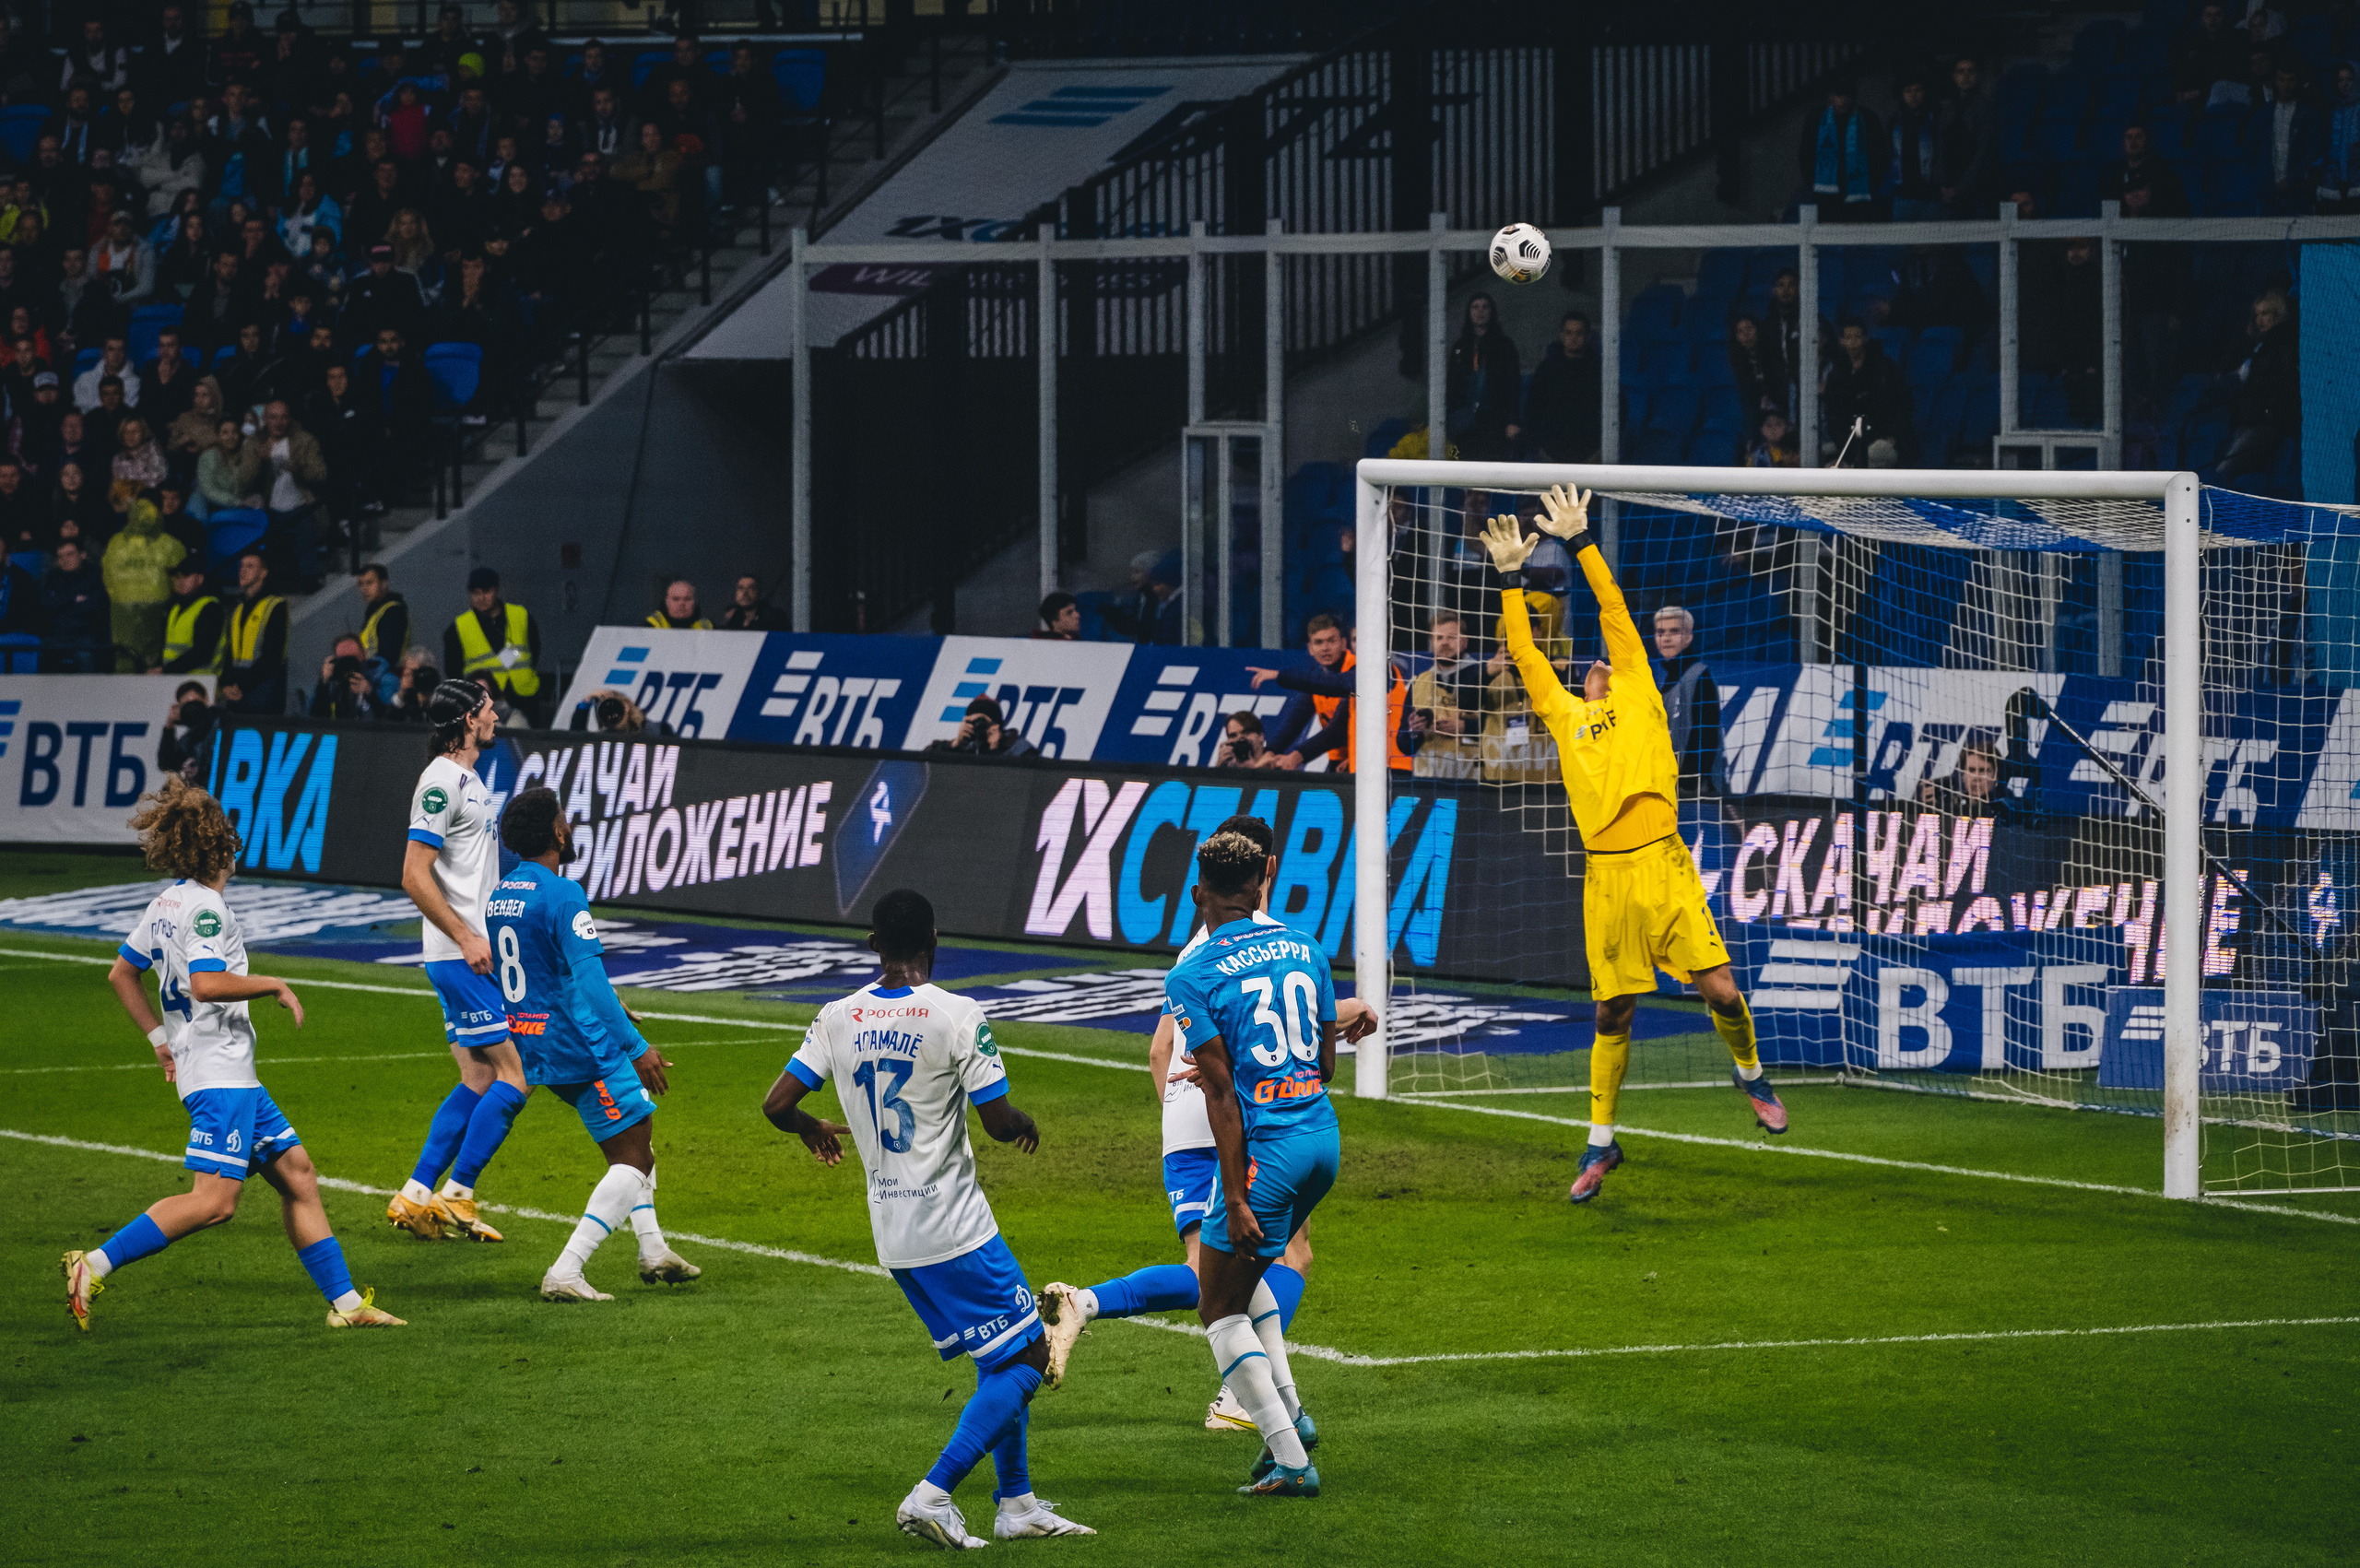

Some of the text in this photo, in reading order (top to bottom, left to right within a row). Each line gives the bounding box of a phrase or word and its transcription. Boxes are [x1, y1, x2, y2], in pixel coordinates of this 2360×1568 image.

[19, 721, 148, 807] ВТБ
[1168, 692, 1287, 768] ВТ
[207, 726, 338, 874] ВКА
[559, 781, 832, 902] РИЛОЖЕНИЕ
[498, 925, 526, 1004] 8
[1215, 939, 1311, 976] КАССЬЕРРА
[469, 1009, 493, 1023] ВТБ
[854, 1029, 925, 1059] НГАМАЛЁ
[867, 1007, 929, 1019] РОССИЯ
[1241, 971, 1319, 1067] 30
[1877, 965, 2109, 1070] ВТБ
[853, 1057, 915, 1153] 13
[977, 1314, 1009, 1340] ВТБ
